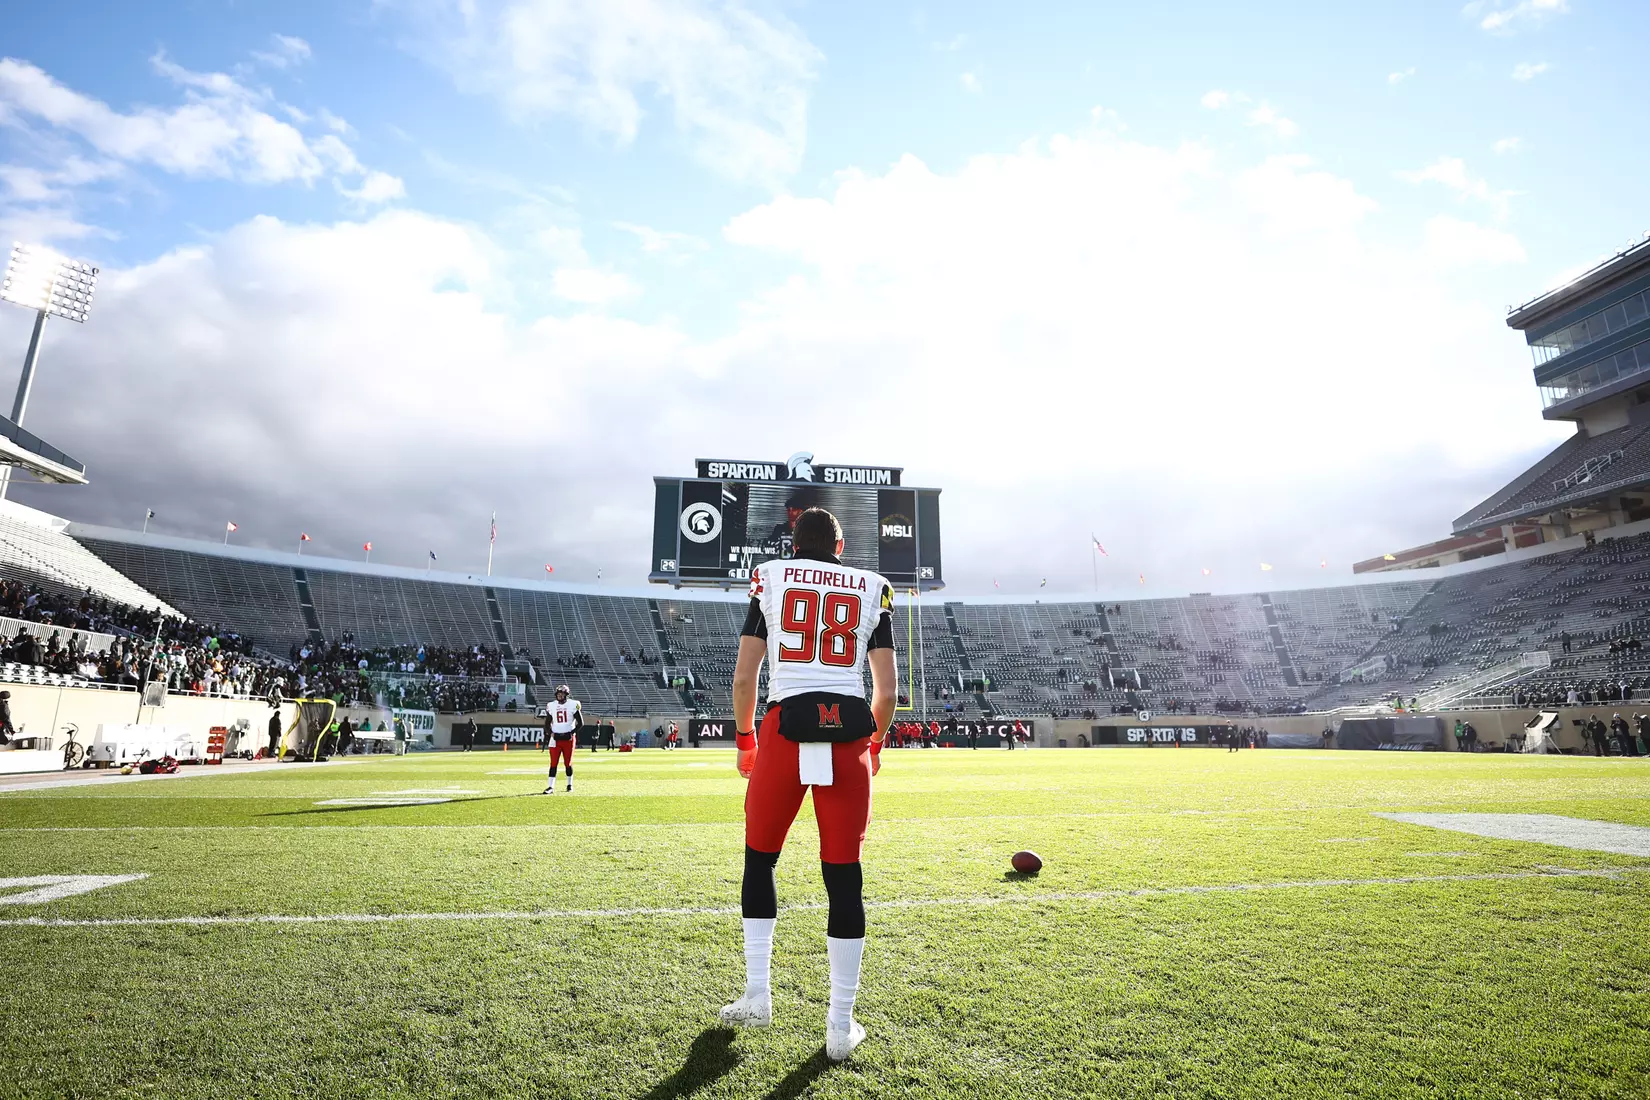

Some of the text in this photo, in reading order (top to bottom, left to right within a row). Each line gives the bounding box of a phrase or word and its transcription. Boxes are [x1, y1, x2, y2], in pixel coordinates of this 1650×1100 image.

[708, 462, 892, 485] SPARTAN STADIUM
[881, 525, 913, 538] MSU
[783, 567, 867, 592] PECORELLA
[779, 588, 861, 667] 98
[556, 711, 568, 724] 61
[816, 703, 842, 725] M
[492, 727, 545, 742] SPARTA
[699, 724, 723, 737] AN
